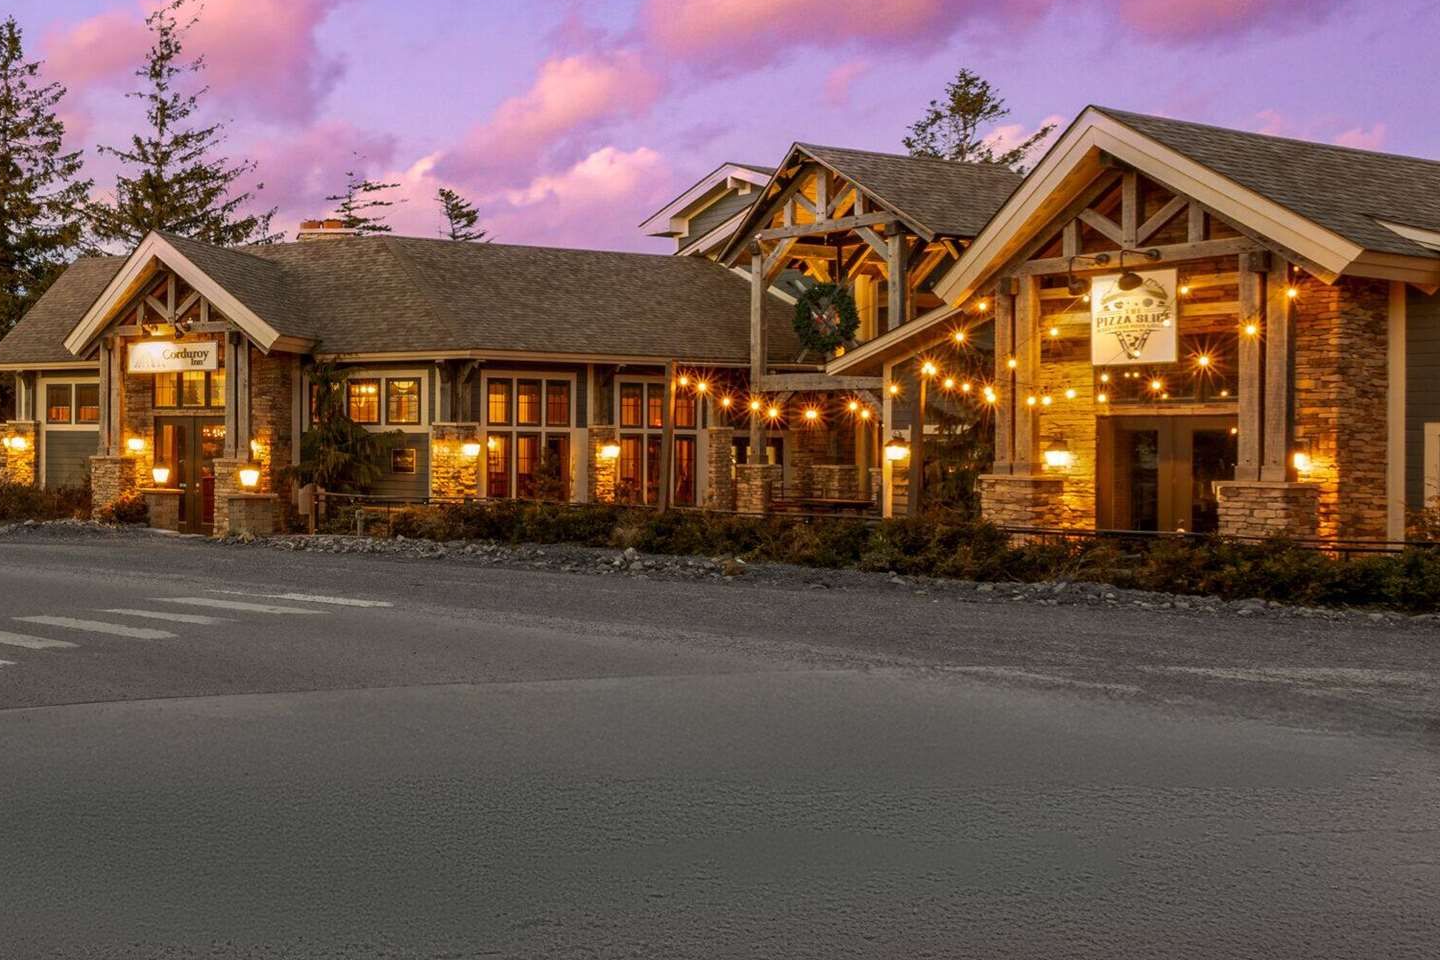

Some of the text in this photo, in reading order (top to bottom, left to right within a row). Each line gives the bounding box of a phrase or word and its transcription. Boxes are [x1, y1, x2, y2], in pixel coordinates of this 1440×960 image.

[1096, 315, 1131, 328] PIZZA
[162, 348, 209, 361] Corduroy
[191, 358, 203, 366] Inn
